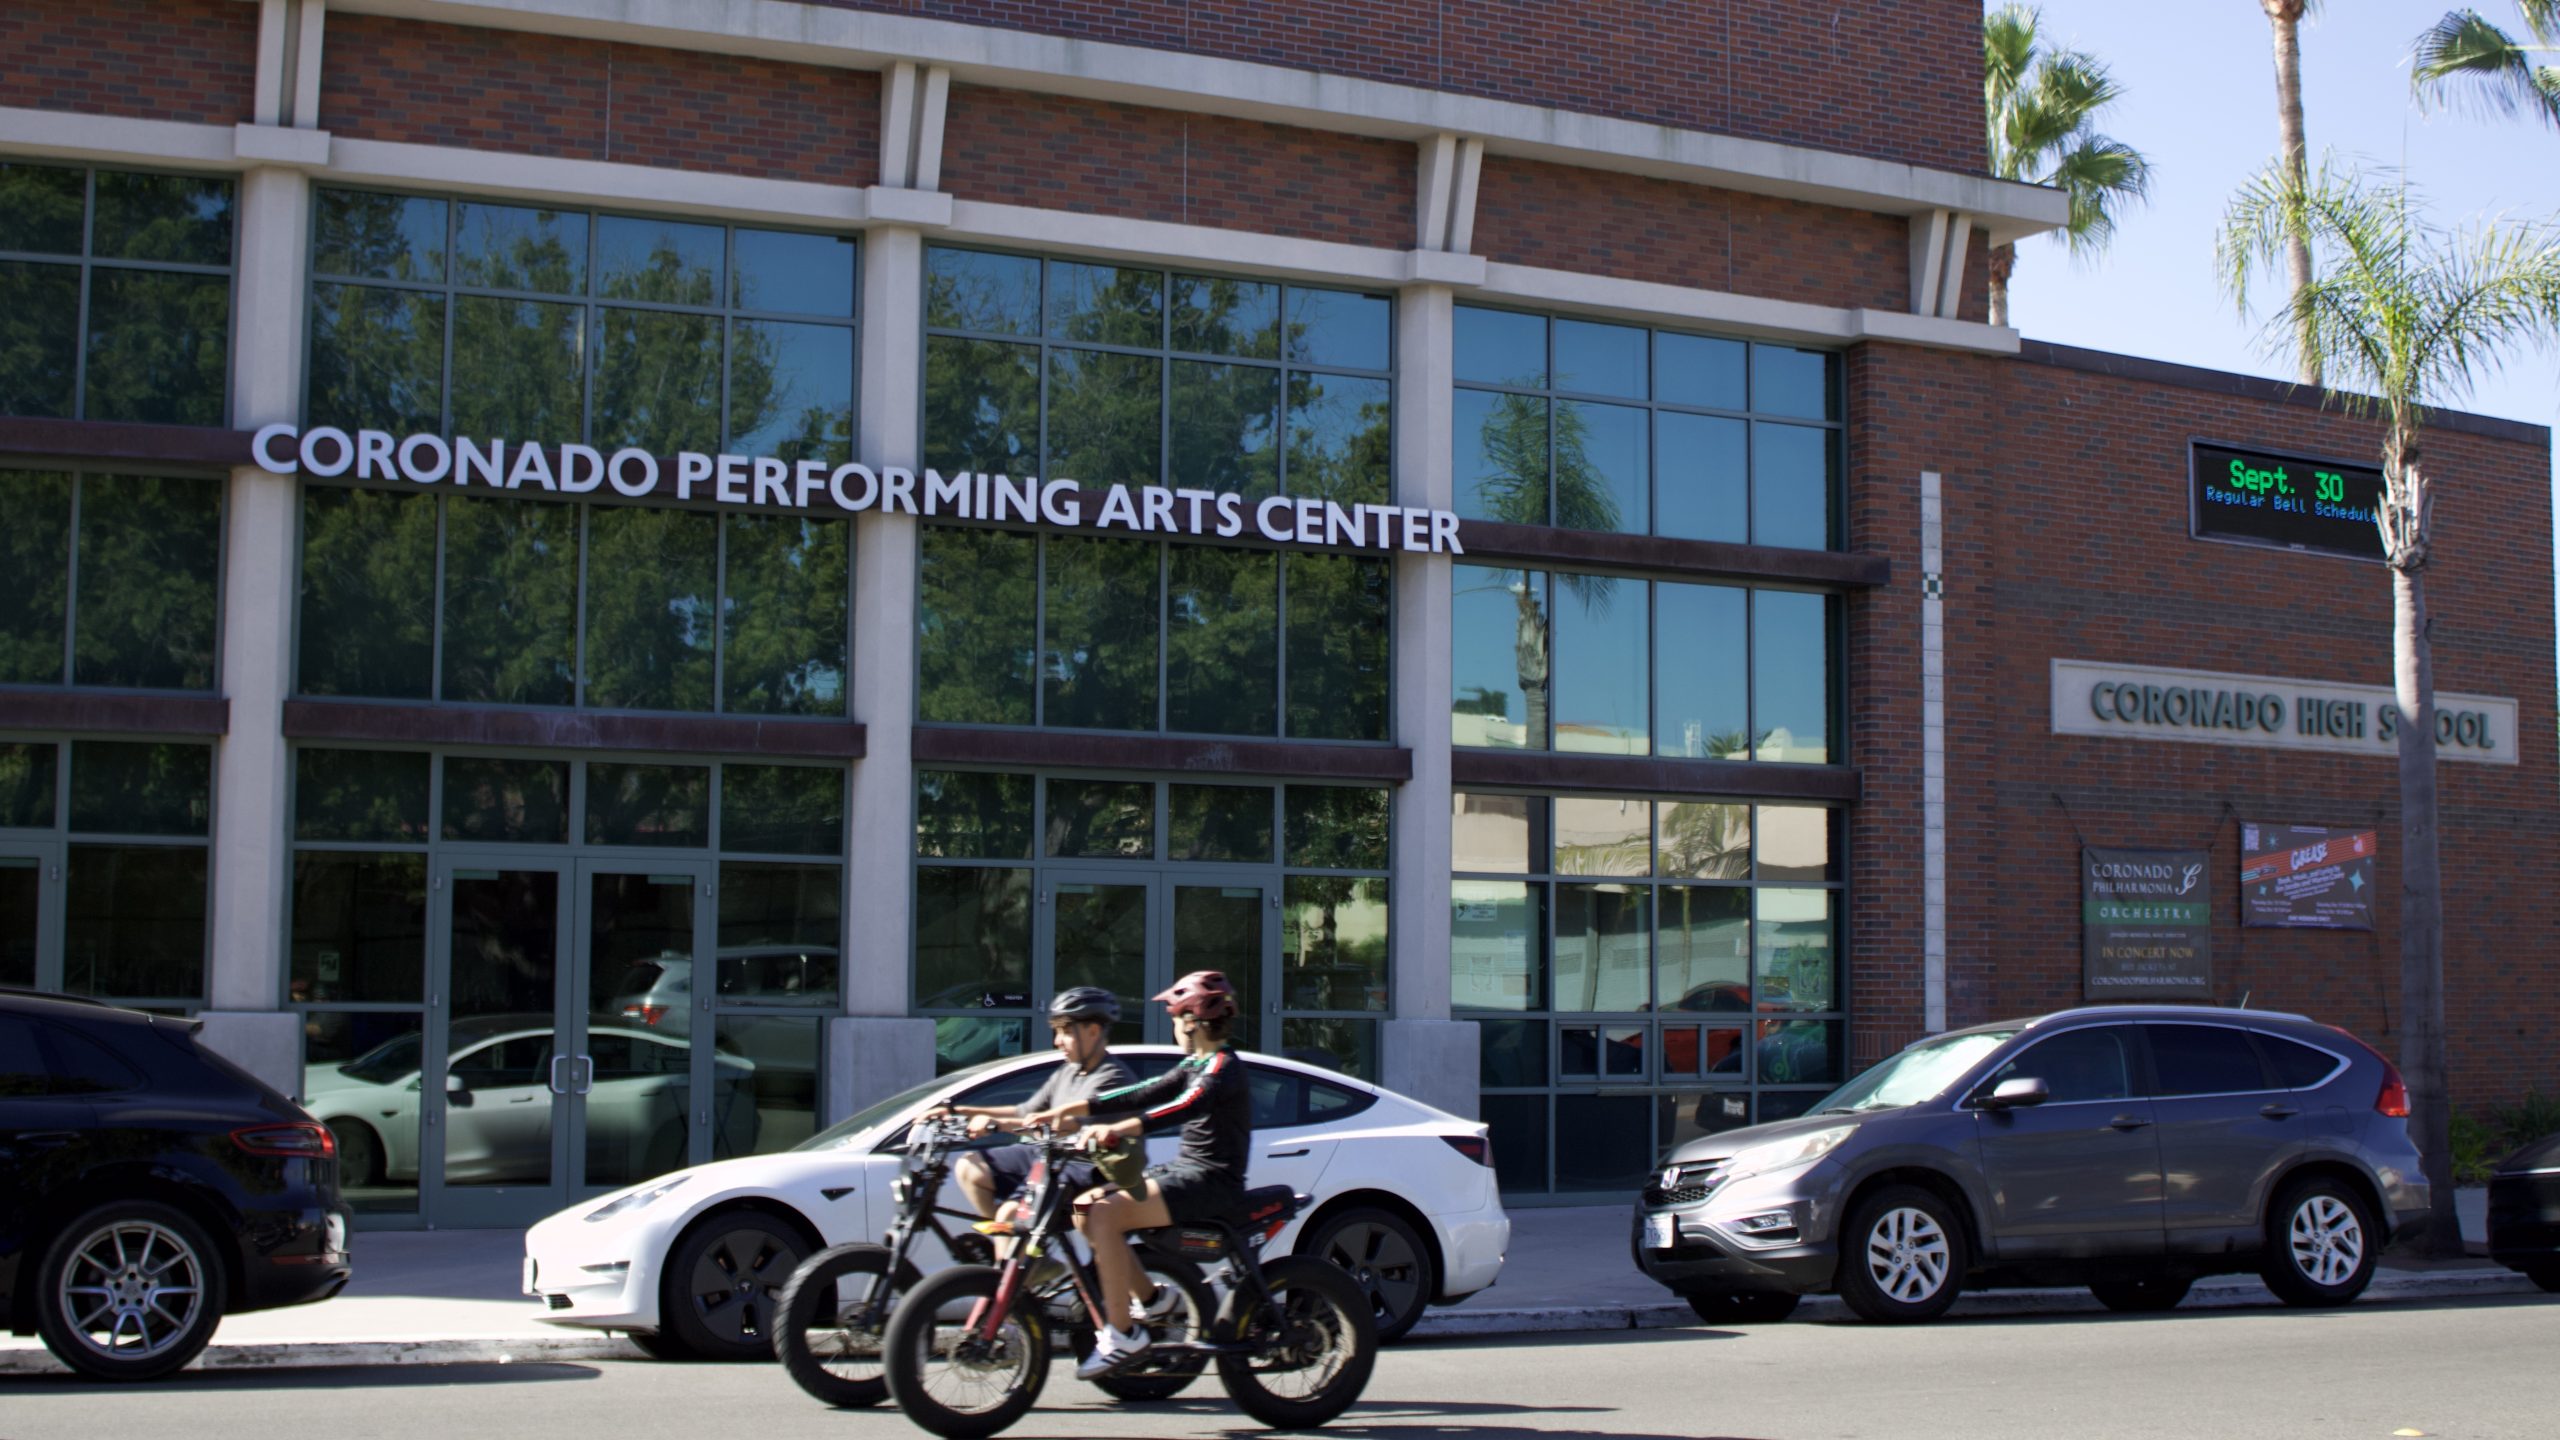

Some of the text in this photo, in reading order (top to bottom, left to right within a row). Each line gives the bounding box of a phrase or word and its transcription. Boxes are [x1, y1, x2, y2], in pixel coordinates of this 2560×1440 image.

[251, 423, 1464, 555] CORONADO PERFORMING ARTS CENTER
[2229, 459, 2344, 502] Sept. 30
[2205, 485, 2266, 508] Regular
[2273, 494, 2307, 514] Bell
[2091, 681, 2496, 749] CORONADO HIGH SOOL
[2091, 863, 2173, 879] CORONADO
[2092, 881, 2174, 895] PHILHARMONIA
[2100, 907, 2192, 920] ORCHESTRA
